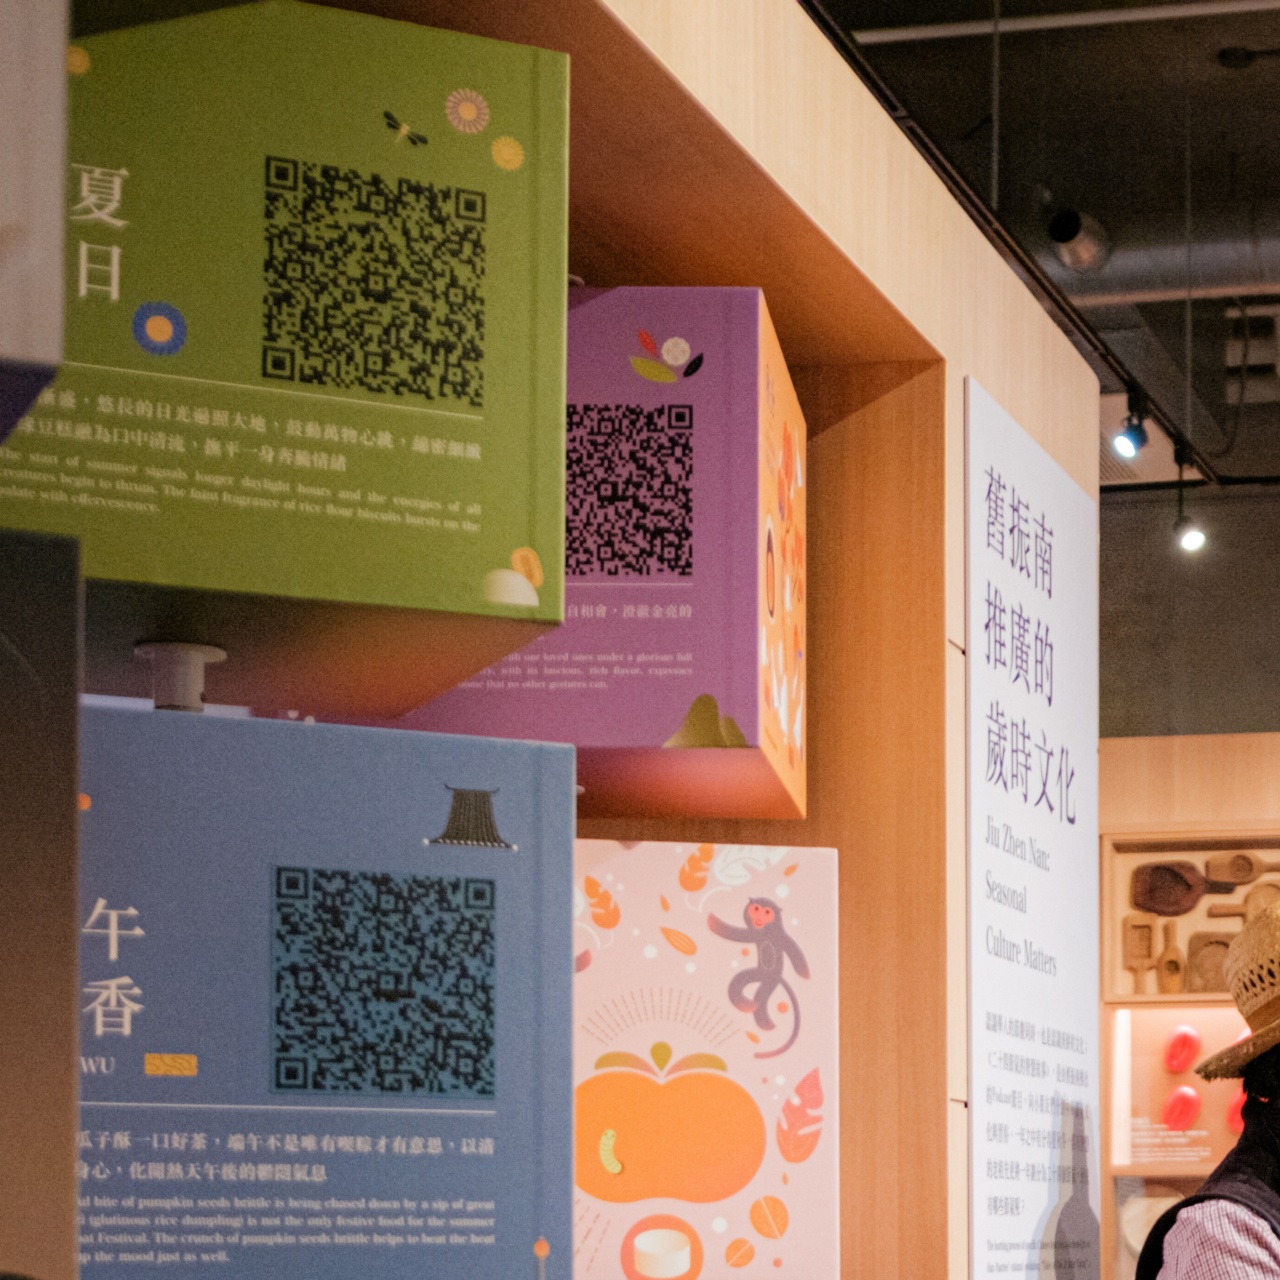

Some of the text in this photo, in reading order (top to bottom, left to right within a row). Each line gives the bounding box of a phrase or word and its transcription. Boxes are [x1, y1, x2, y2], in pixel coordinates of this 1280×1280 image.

[70, 163, 129, 228] 夏
[77, 240, 121, 301] 日
[984, 465, 1054, 599] 舊振南
[983, 579, 1054, 708] 推廣的
[984, 700, 1077, 826] 歲時文化
[985, 815, 1051, 873] Jiu Zhen Nan:
[985, 870, 1028, 915] Seasonal
[81, 897, 146, 961] 午
[985, 925, 1058, 977] Culture Matters
[82, 975, 145, 1037] 香
